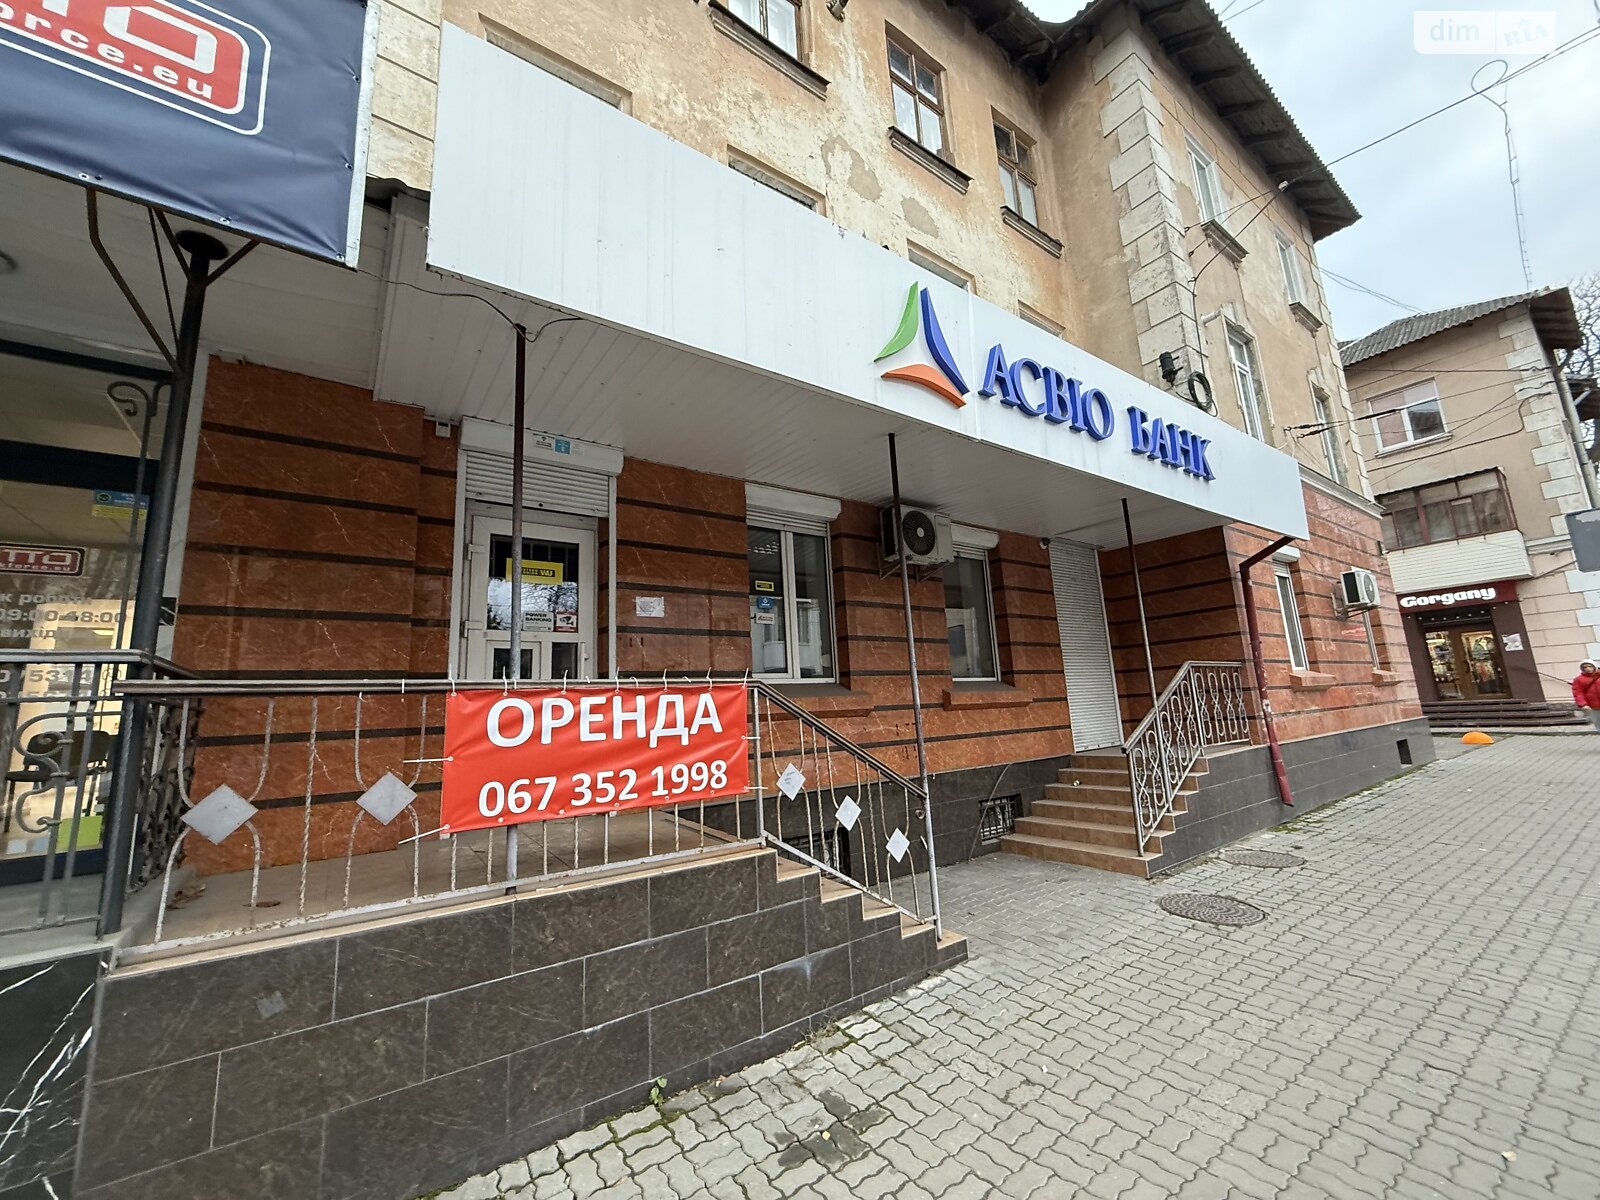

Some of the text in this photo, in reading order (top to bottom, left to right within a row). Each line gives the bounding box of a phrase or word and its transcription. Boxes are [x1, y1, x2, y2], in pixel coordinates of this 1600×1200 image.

[977, 343, 1216, 481] АСВІО БАНК
[1400, 587, 1497, 608] Gorgany
[486, 692, 723, 748] ОРЕНДА
[478, 776, 557, 818] 067
[570, 768, 639, 807] 352
[651, 759, 728, 797] 1998
